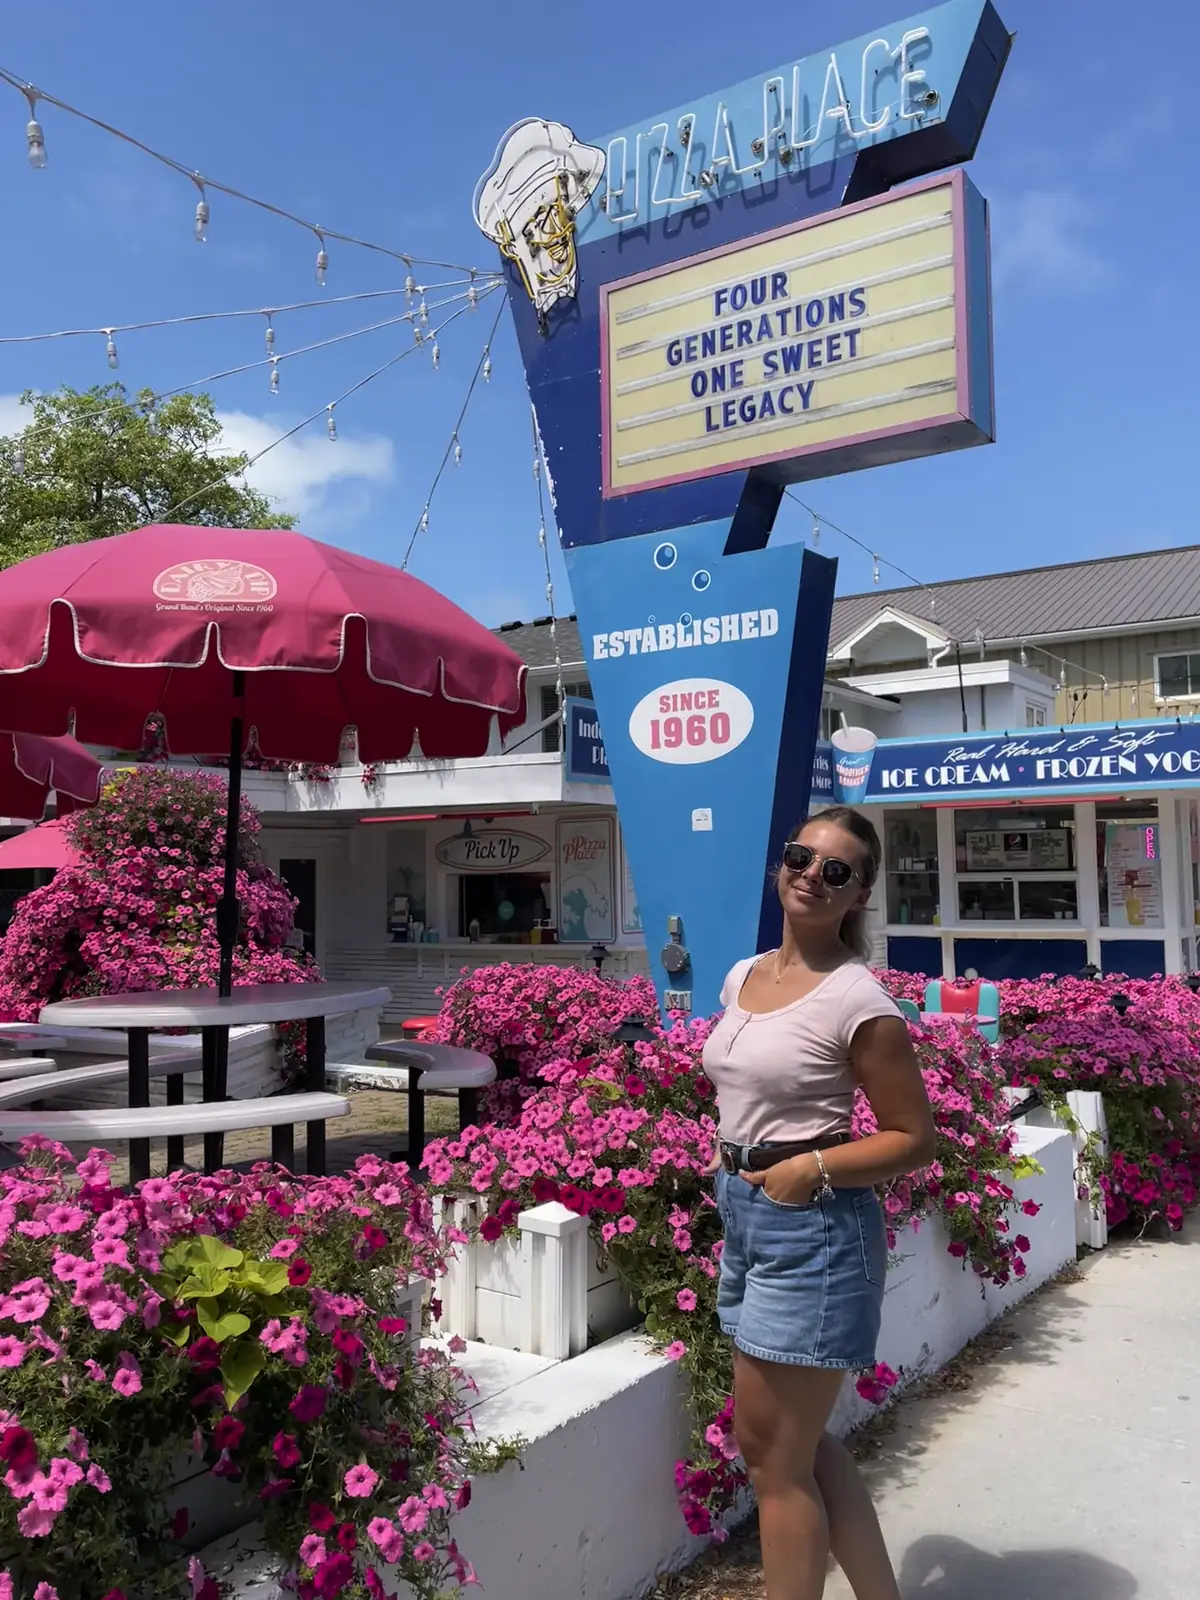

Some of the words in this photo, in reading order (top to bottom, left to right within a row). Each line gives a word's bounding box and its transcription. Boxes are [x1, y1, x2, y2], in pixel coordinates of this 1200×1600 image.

[714, 271, 788, 316] FOUR
[666, 287, 866, 367] GENERATIONS
[690, 359, 744, 398] ONE
[763, 328, 861, 379] SWEET
[705, 379, 816, 432] LEGACY
[155, 602, 179, 612] Grand
[204, 604, 235, 613] Original
[235, 604, 255, 612] Since
[256, 604, 274, 612] 1960
[592, 608, 780, 660] ESTABLISHED
[659, 689, 720, 714] SINCE
[650, 711, 731, 750] 1960
[943, 744, 997, 764] Real
[995, 739, 1067, 759] Hard
[1100, 730, 1175, 755] Soft
[882, 768, 919, 789] ICE
[925, 762, 1011, 787] CREAM
[1036, 754, 1137, 780] FROZEN
[464, 839, 497, 860] Pick
[498, 837, 520, 864] Up
[562, 843, 599, 864] Place
[571, 834, 607, 852] Pizza
[1145, 826, 1155, 859] OPEN
